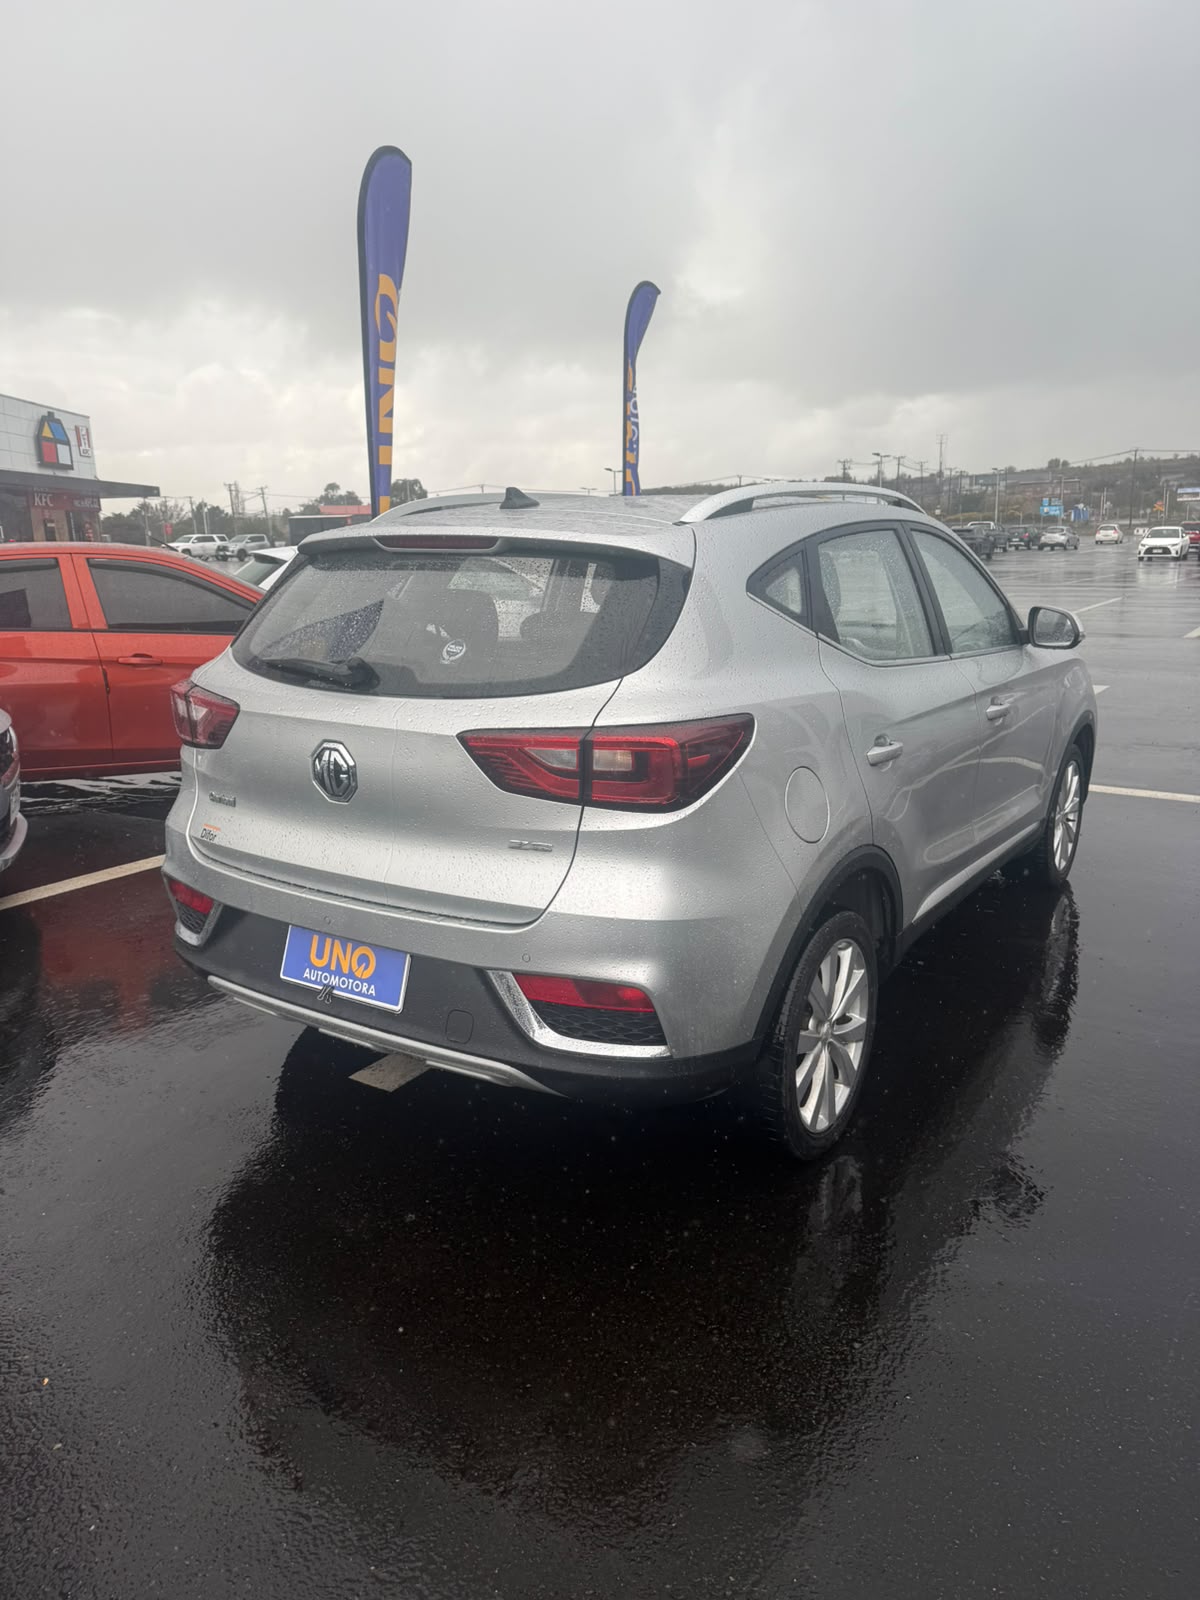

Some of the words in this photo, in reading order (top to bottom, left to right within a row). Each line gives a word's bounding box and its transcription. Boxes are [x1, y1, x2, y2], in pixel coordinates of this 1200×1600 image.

[34, 493, 54, 507] KFC
[313, 748, 352, 798] MG
[200, 828, 217, 842] Difor
[309, 934, 377, 980] UNO
[302, 967, 377, 997] AUTOMOTORA
